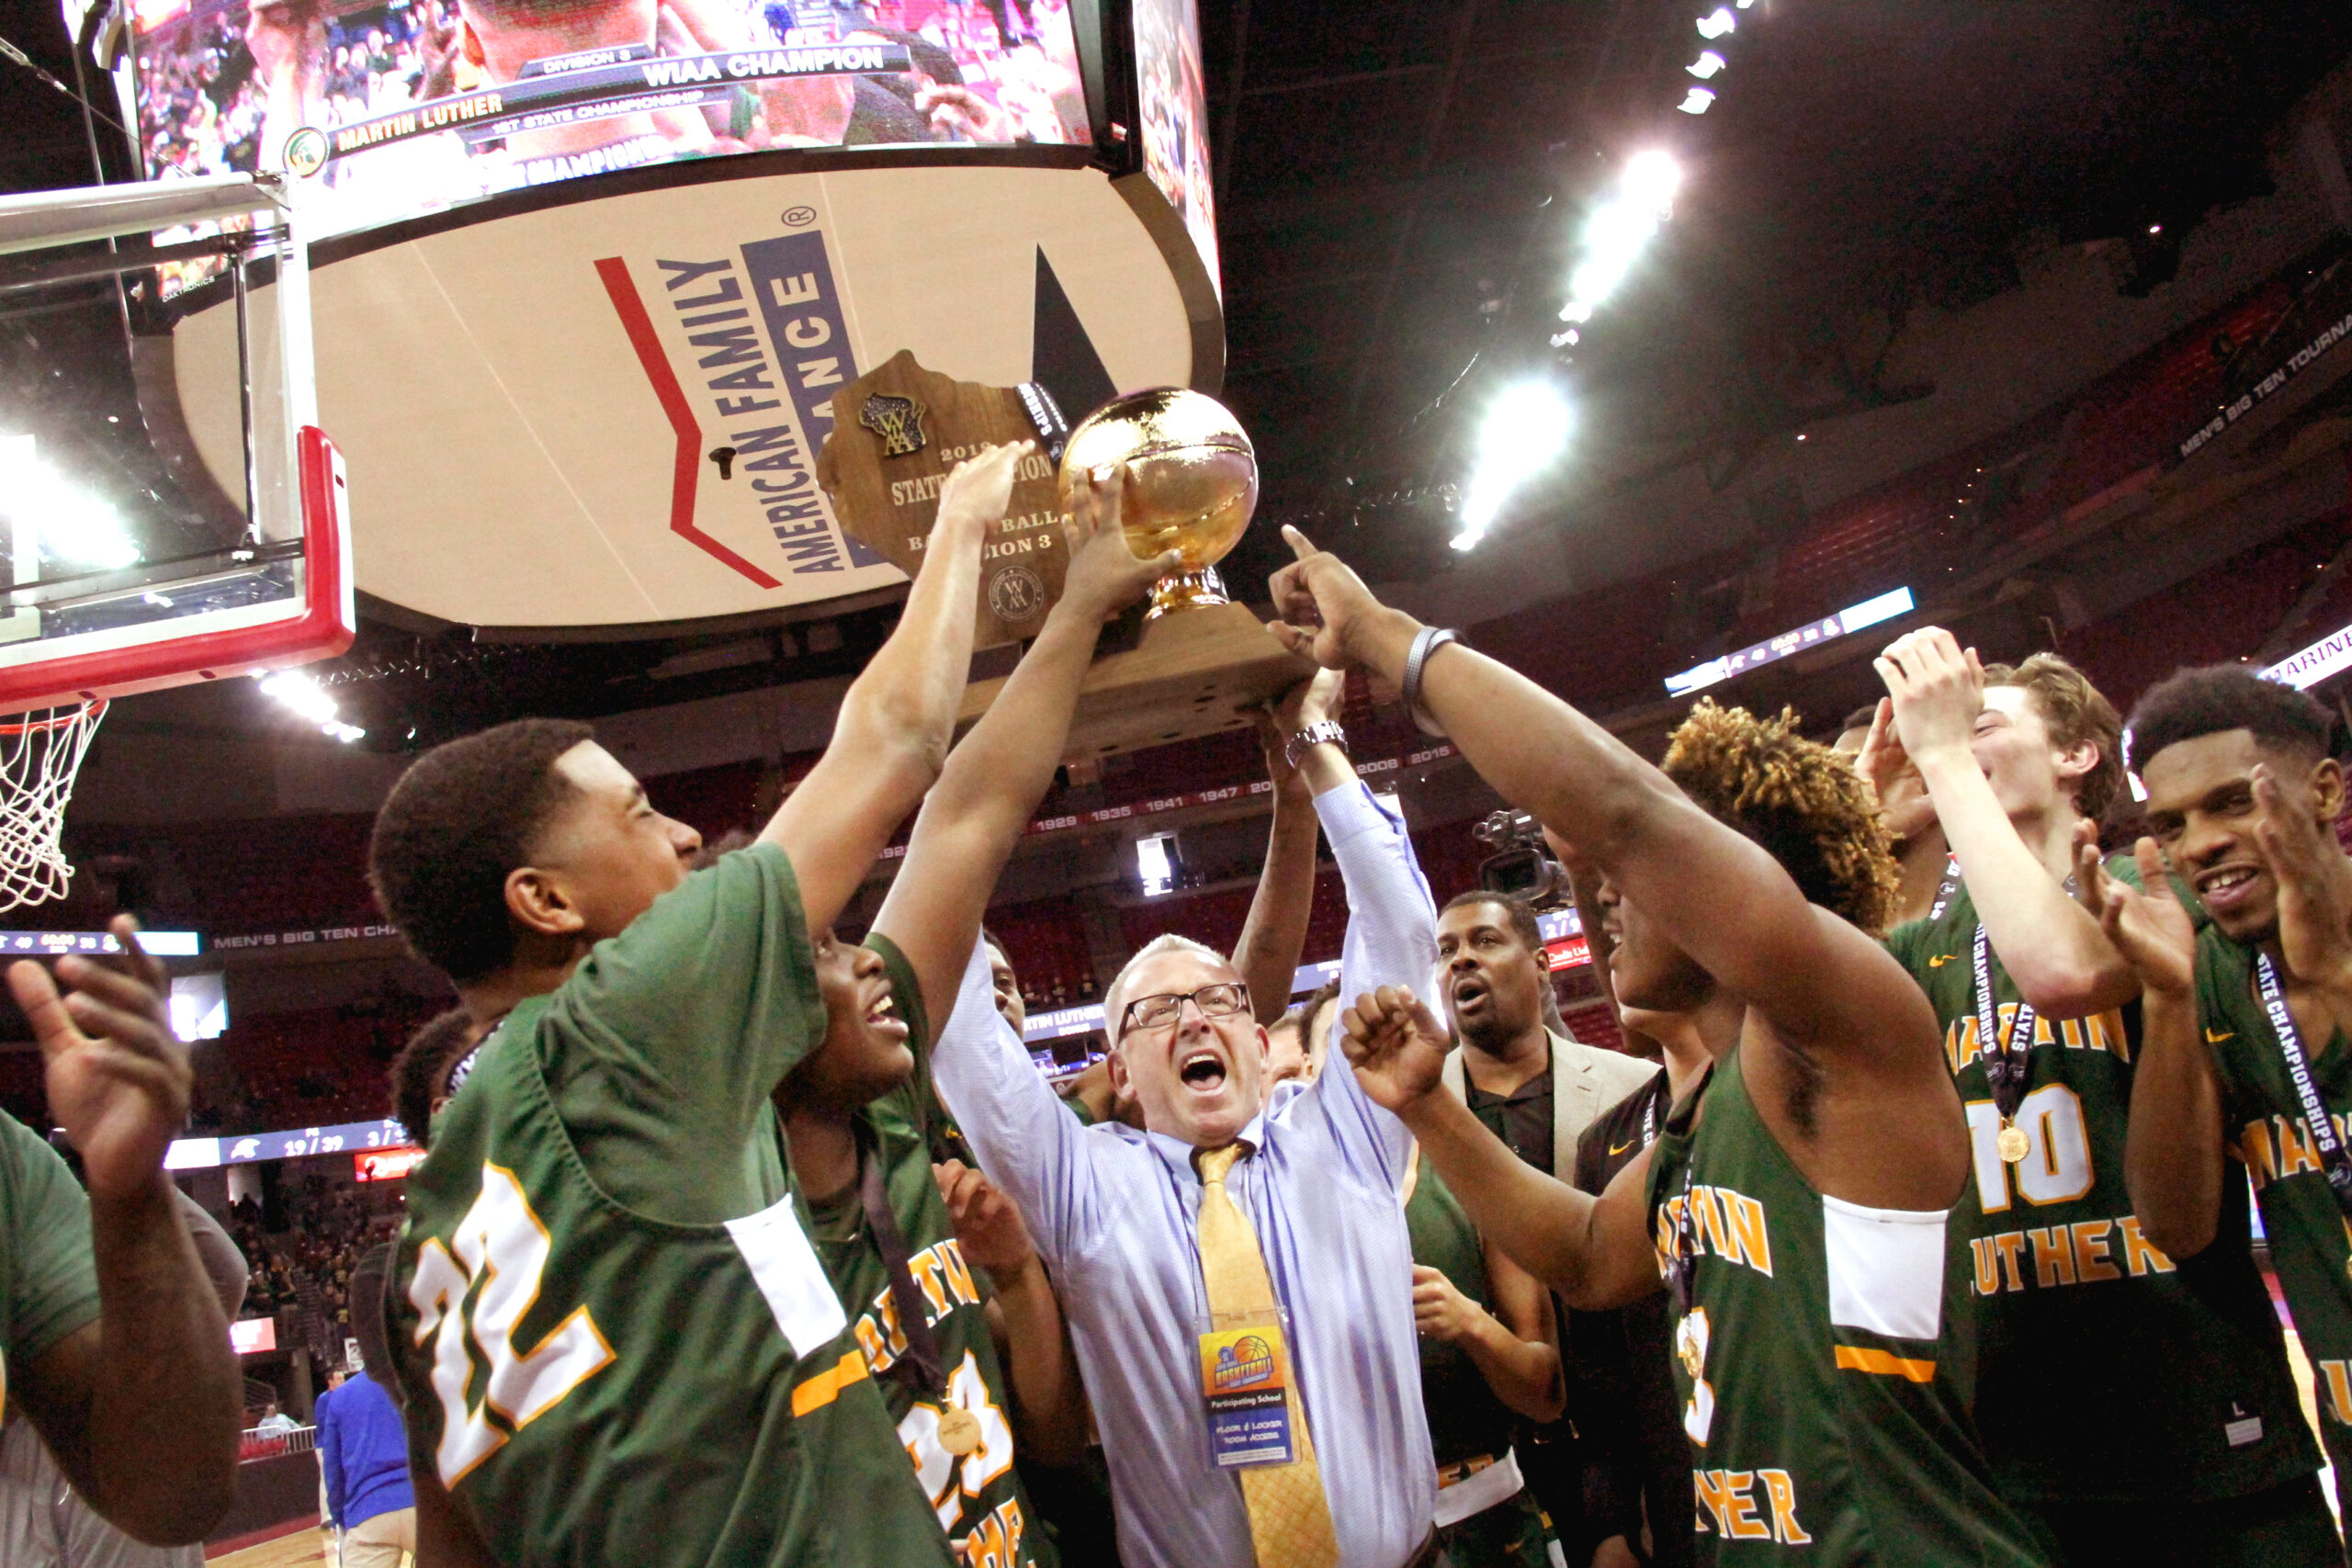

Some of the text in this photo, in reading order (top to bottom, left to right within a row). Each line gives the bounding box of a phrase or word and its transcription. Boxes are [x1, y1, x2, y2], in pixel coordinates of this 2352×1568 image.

[544, 50, 632, 74] DIVISION 3
[642, 46, 884, 87] WIAA CHAMPION
[337, 94, 503, 152] MARTIN LUTHER
[524, 110, 574, 129] STATE
[577, 91, 705, 120] CHAMPIONSHIP
[162, 276, 216, 303] DAKTRONICS
[656, 258, 845, 574] AMERICAN FAMILY
[2180, 416, 2225, 457] MEN'S
[2226, 395, 2253, 422] BIG
[2253, 368, 2287, 400] TEN
[1038, 534, 1052, 549] 3
[1036, 815, 1078, 830] 1929
[1091, 806, 1132, 821] 1935
[1146, 796, 1184, 812] 1941
[1198, 787, 1238, 802] 1947
[1250, 781, 1273, 794] 20
[1356, 758, 1398, 774] 2008
[1410, 745, 1450, 764] 2015
[213, 933, 277, 949] MEN'S
[282, 931, 315, 943] BIG
[321, 927, 358, 941] TEN
[1973, 941, 1997, 1055] CHAMPIONSHIPS
[2257, 952, 2336, 1152] STATE CHAMPIONSHIPS
[1964, 1082, 2096, 1213] 10
[409, 1158, 617, 1492] 12
[1211, 1393, 1282, 1408] Participating School
[2232, 1401, 2245, 1416] L
